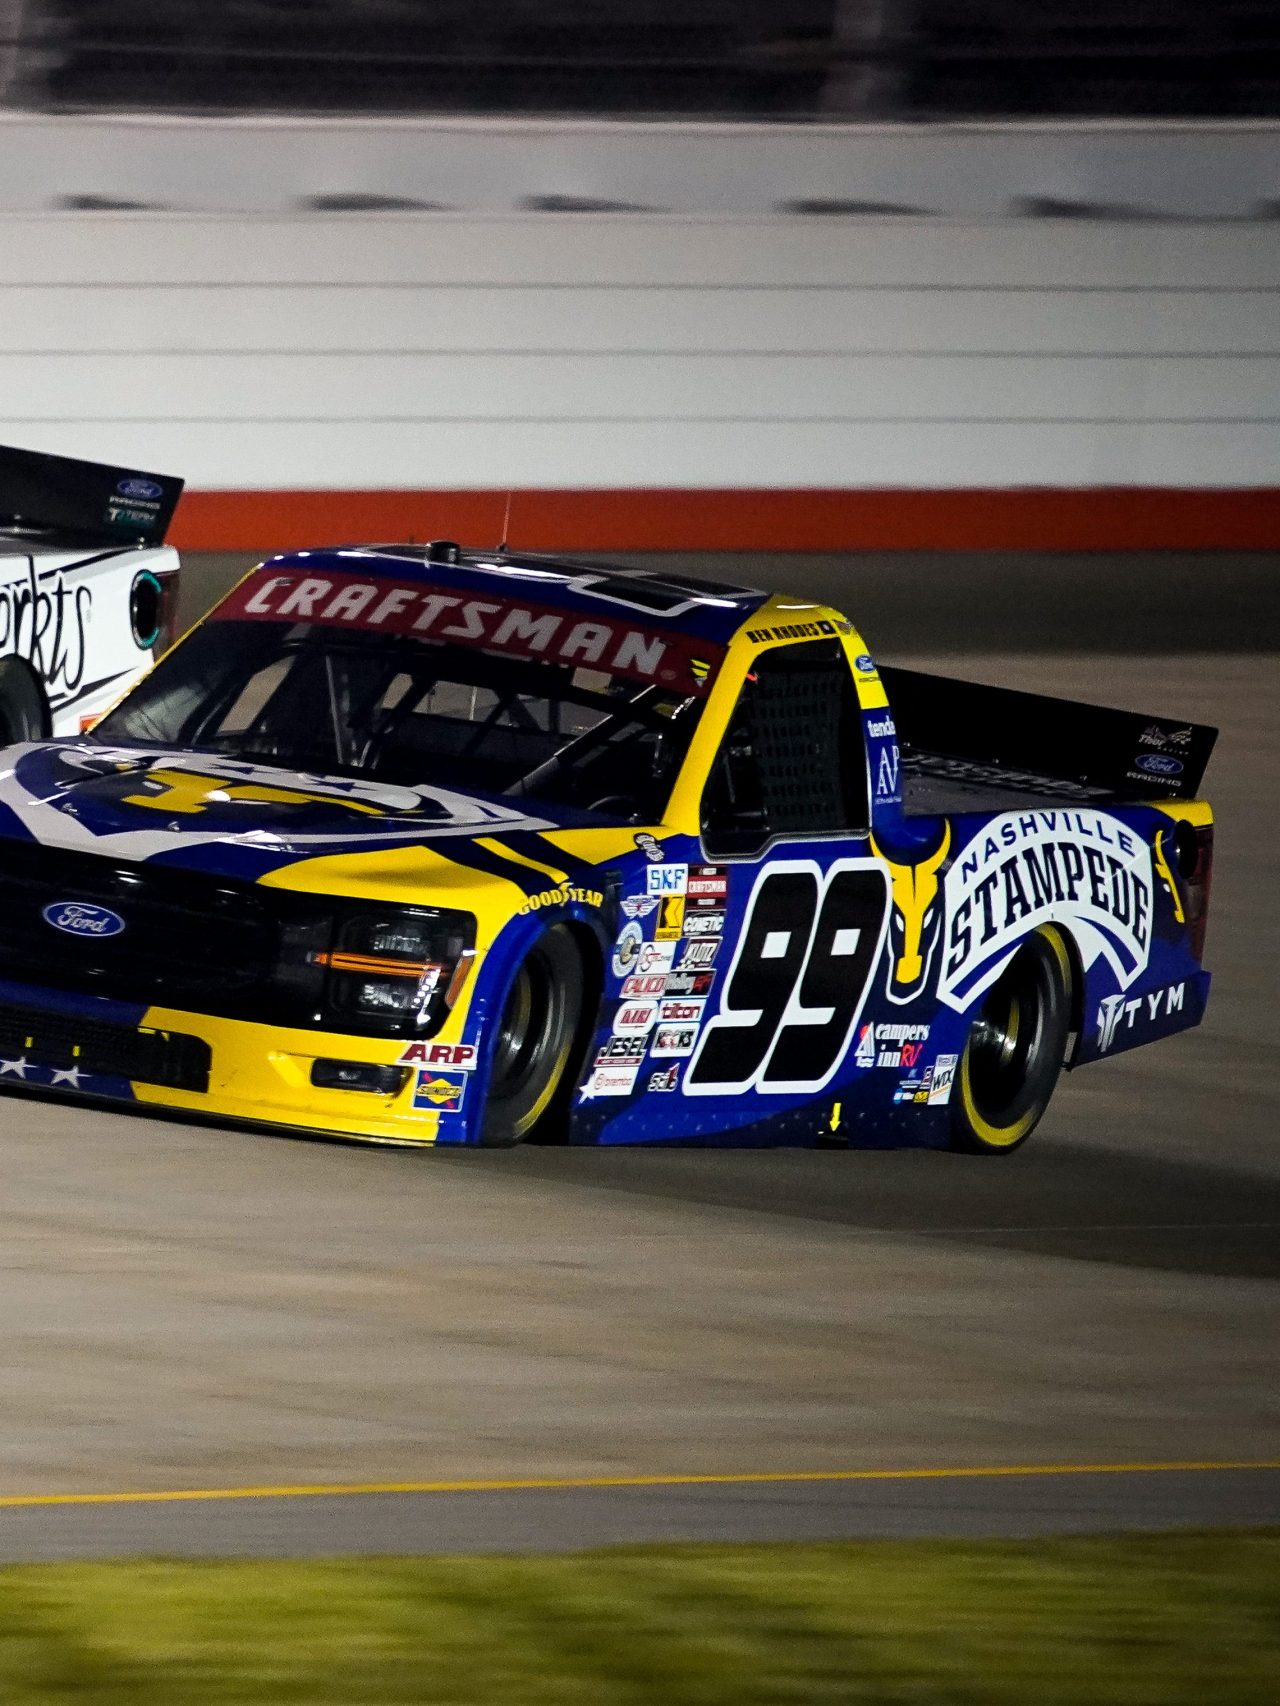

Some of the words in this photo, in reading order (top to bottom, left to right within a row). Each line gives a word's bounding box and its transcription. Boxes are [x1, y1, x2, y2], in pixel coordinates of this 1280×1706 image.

[243, 576, 668, 675] CRAFTSMAN
[745, 629, 773, 644] BEN
[771, 622, 820, 640] RHODES
[961, 812, 1135, 885] NASHVILLE
[650, 868, 686, 891] SKF
[517, 882, 604, 916] GOODYEAR
[947, 841, 1149, 979] STAMPEDE
[57, 905, 111, 933] Ford
[689, 869, 888, 1084] 99
[1125, 982, 1186, 1029] TYM
[874, 1023, 931, 1048] campers
[400, 1043, 474, 1064] ARP
